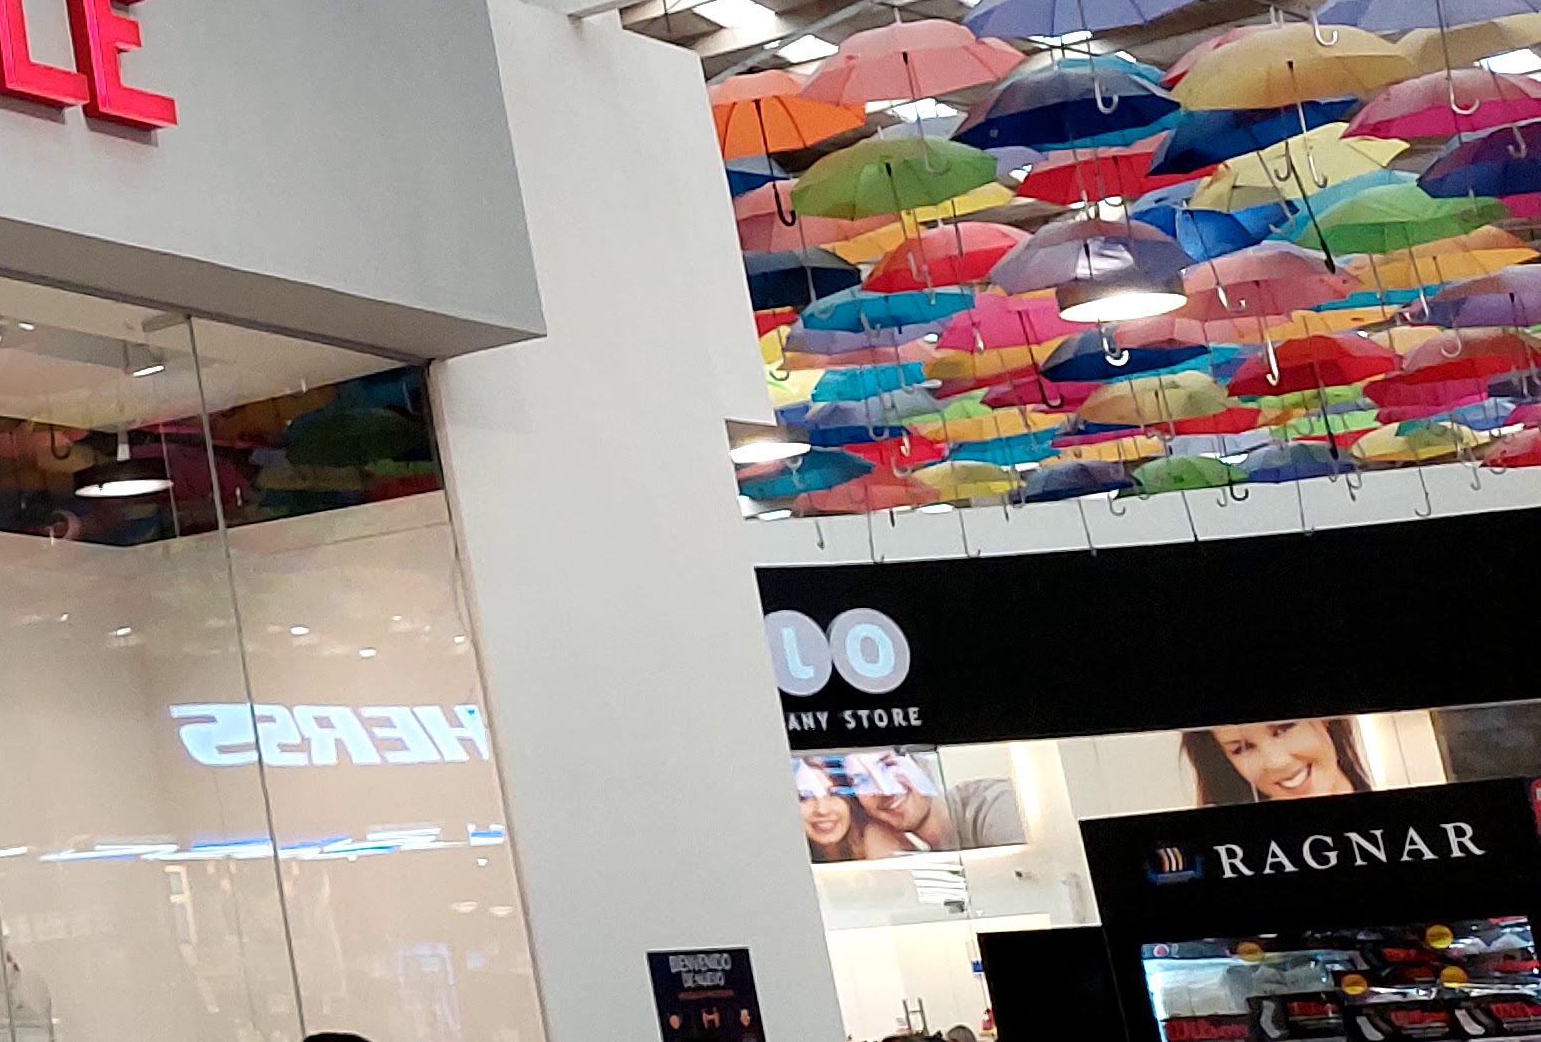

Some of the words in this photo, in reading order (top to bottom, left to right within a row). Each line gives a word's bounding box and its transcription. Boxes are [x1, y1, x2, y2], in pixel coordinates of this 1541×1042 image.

[787, 710, 830, 732] ANY
[843, 706, 923, 730] STORE
[1212, 820, 1486, 880] RAGNAR
